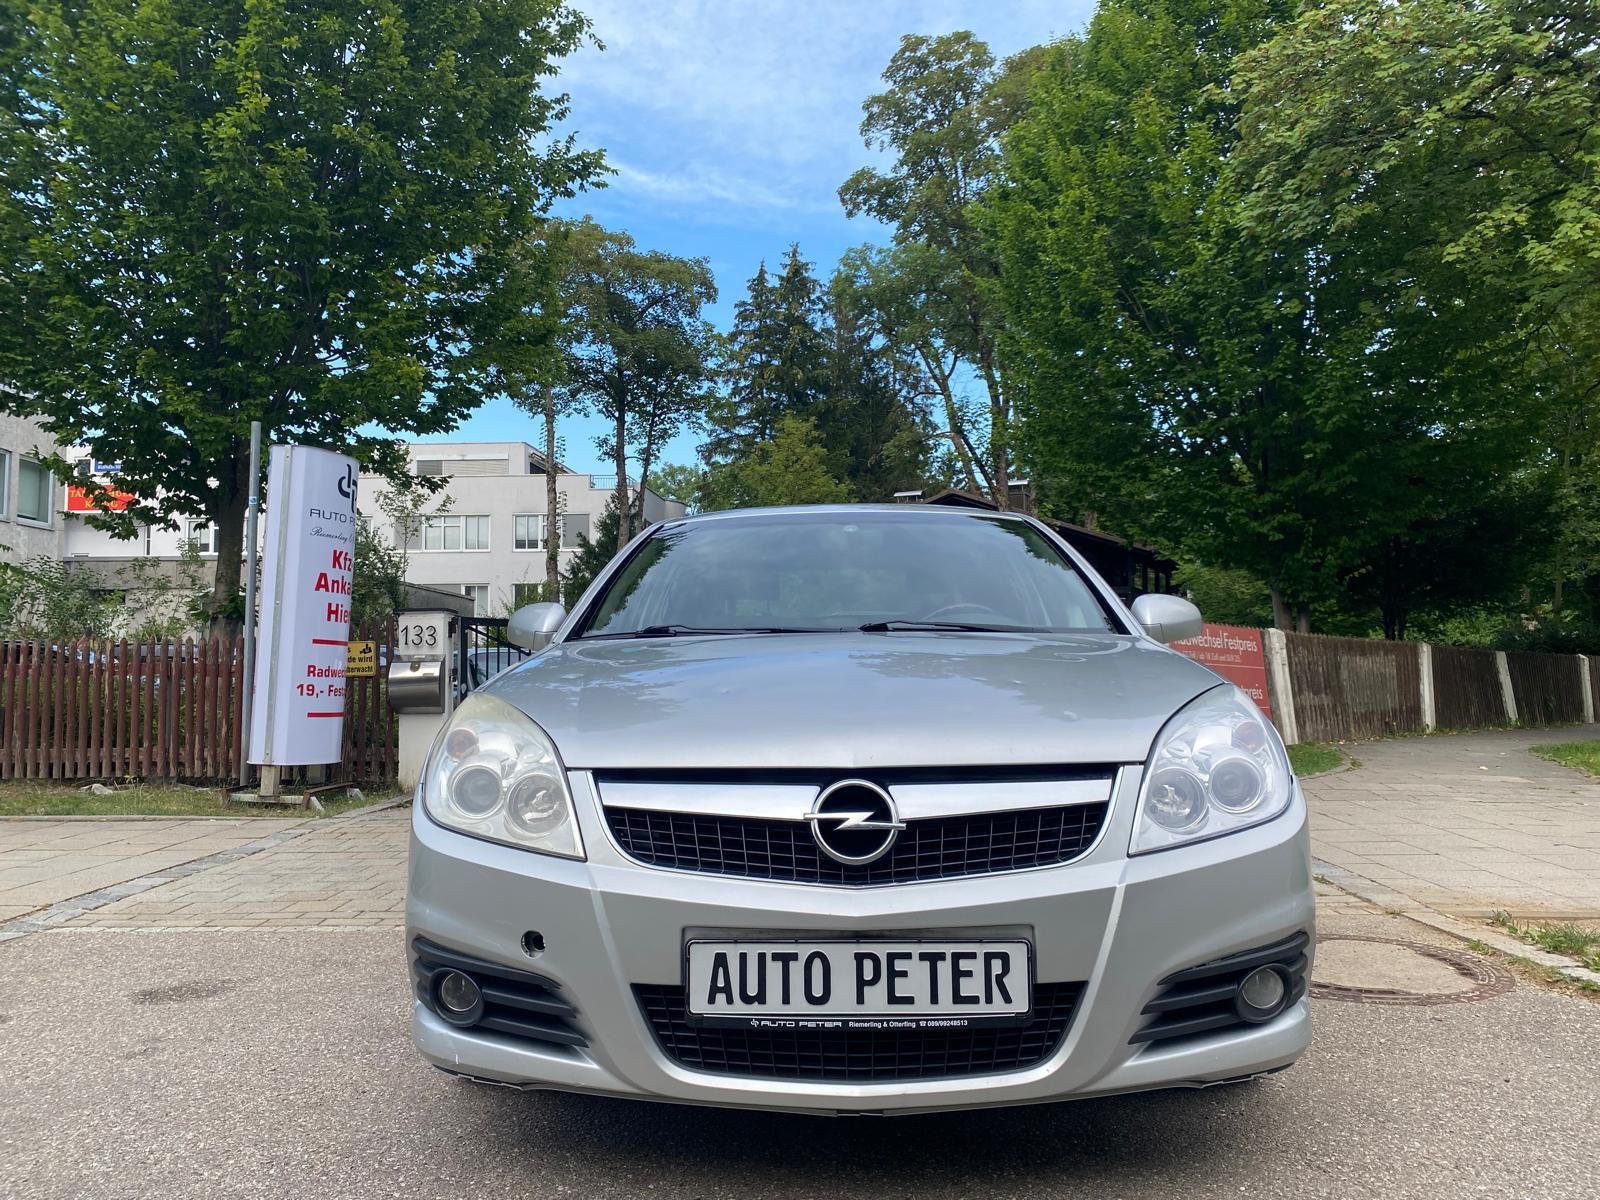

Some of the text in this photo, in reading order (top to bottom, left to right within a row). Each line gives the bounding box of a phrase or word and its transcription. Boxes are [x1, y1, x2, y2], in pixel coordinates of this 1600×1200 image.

[310, 508, 347, 523] AUTO
[332, 549, 352, 572] Kfz
[400, 625, 437, 647] 133
[1223, 632, 1257, 655] Festpreis
[357, 655, 373, 663] wird
[296, 683, 324, 699] 19,-
[707, 950, 1014, 1006] AUTO PETER
